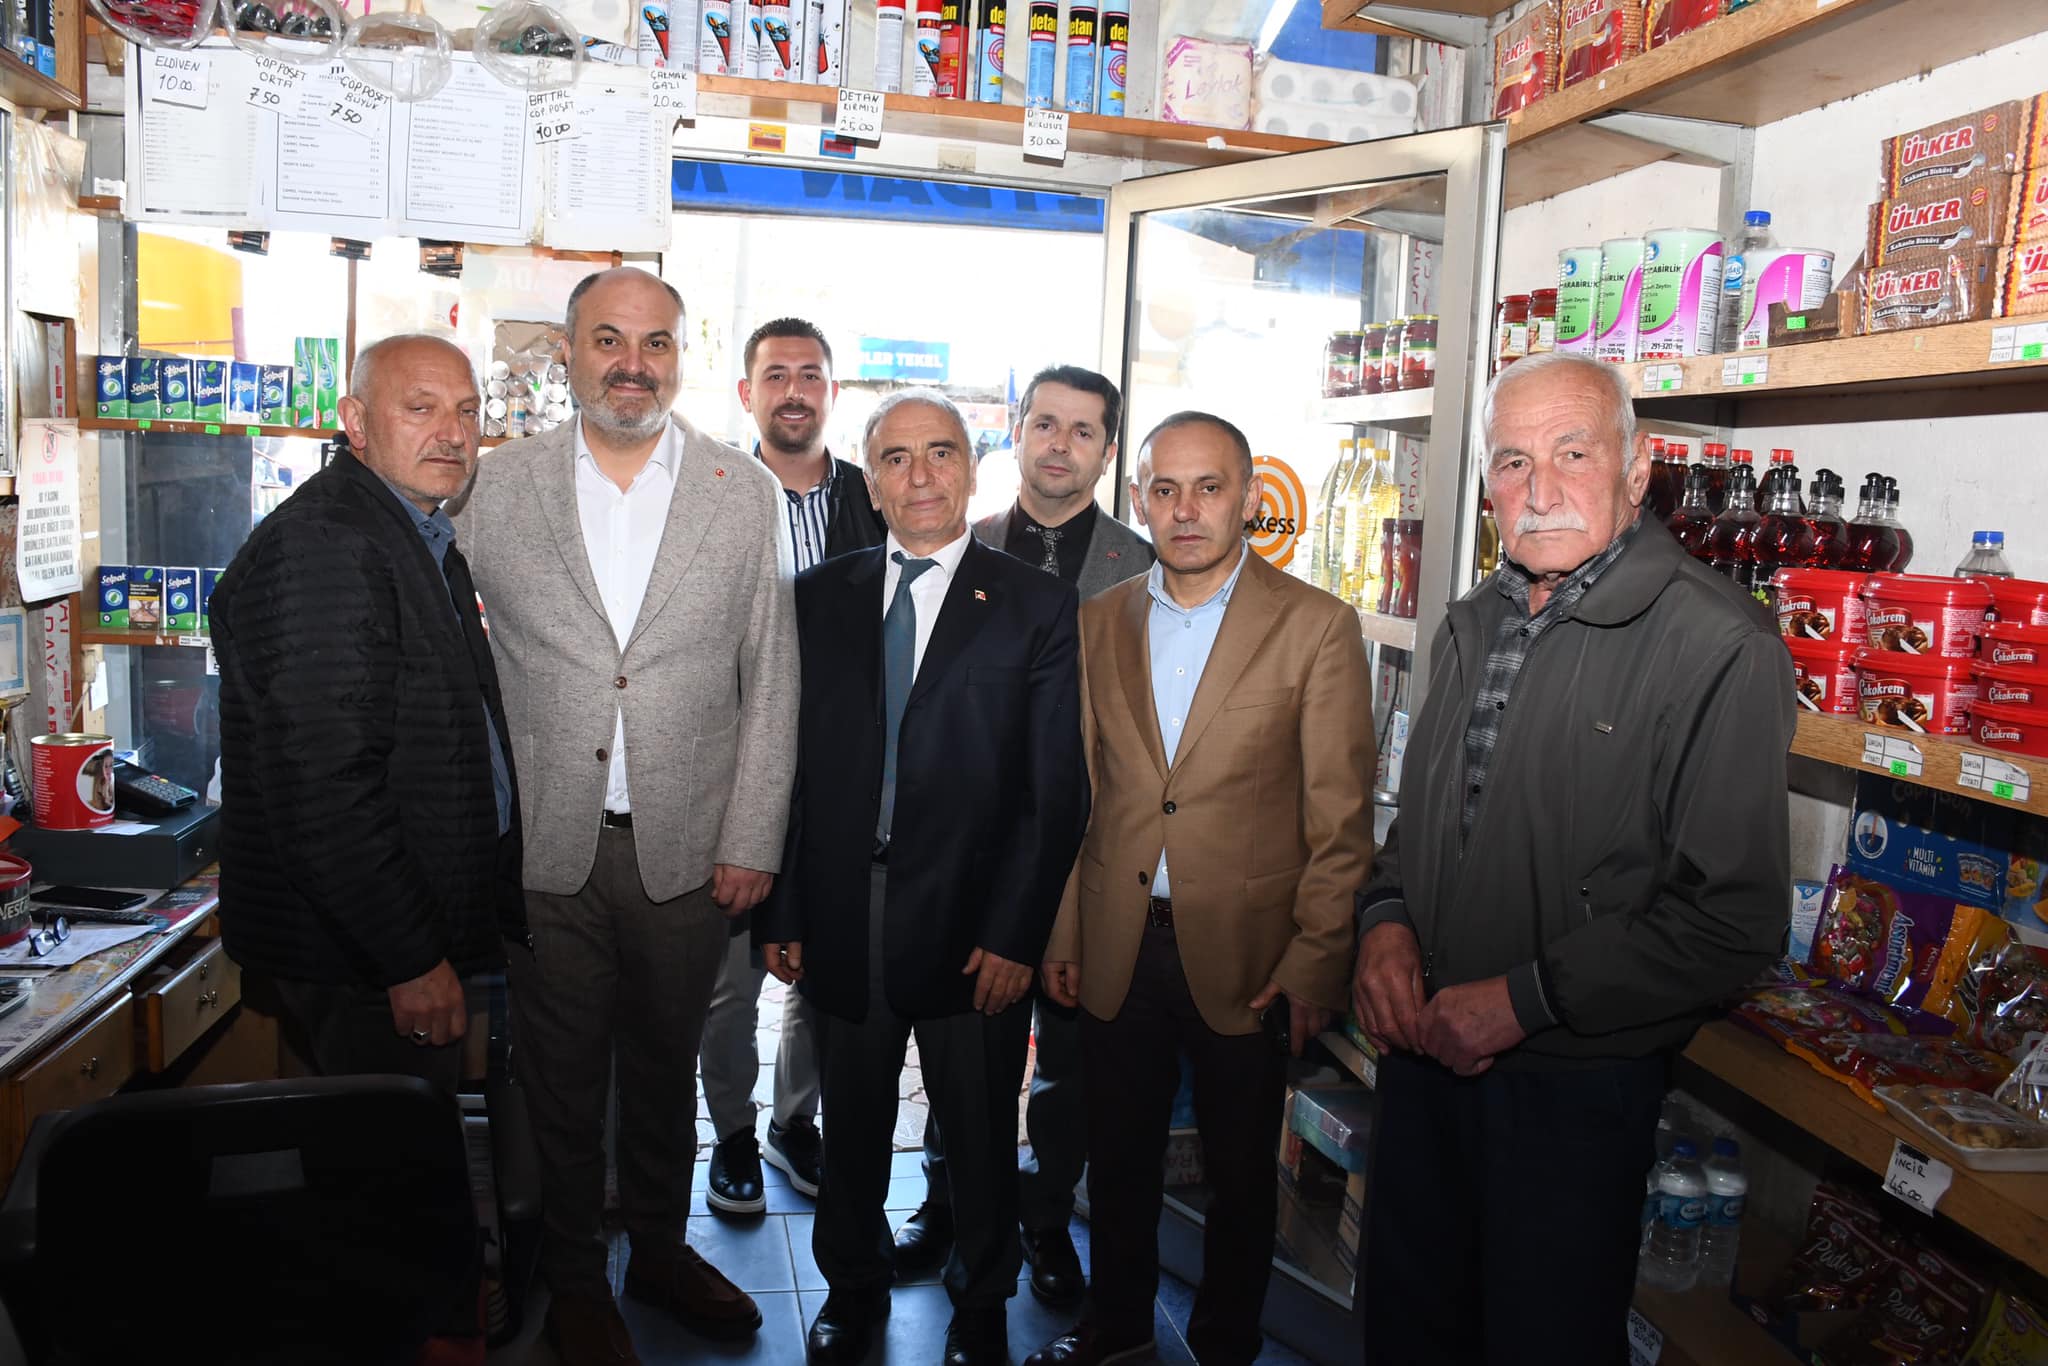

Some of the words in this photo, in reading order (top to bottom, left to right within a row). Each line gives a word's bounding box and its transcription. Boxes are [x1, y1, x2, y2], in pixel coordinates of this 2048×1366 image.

[1069, 18, 1093, 36] etan
[259, 71, 293, 89] ORTA
[529, 89, 570, 106] BATTAL
[840, 89, 879, 102] DETAN
[1027, 109, 1063, 120] DTAN
[1028, 121, 1063, 130] KKUSUZ
[1902, 126, 1974, 167] ÜLKER
[1889, 198, 1961, 233] ÜLKER
[1875, 268, 1941, 300] ÜLKER
[131, 382, 158, 396] Selpak
[195, 384, 224, 397] Selpak
[1244, 515, 1296, 535] Axess
[101, 572, 127, 585] Selpak
[167, 575, 192, 588] Selpak
[1920, 946, 1940, 977] Kent
[1881, 1286, 1944, 1341] Puding
